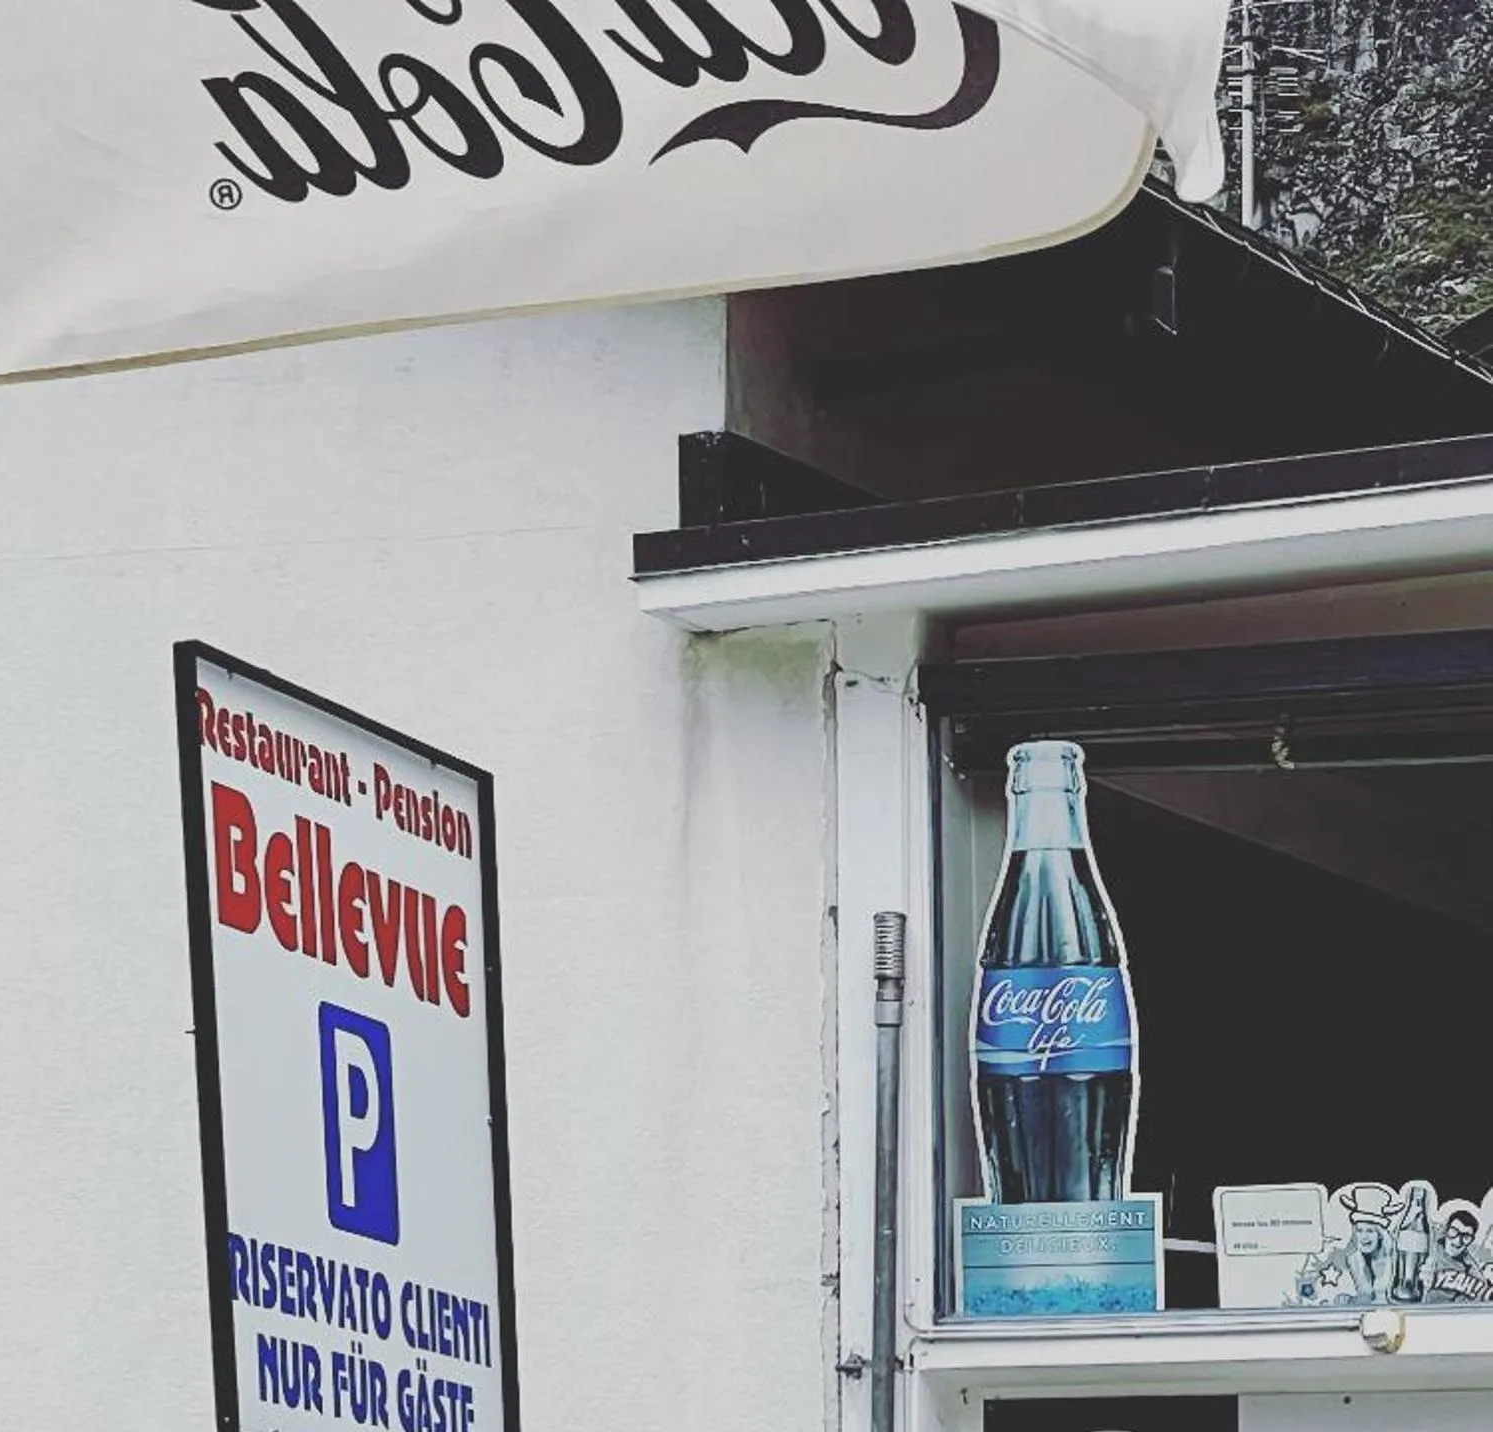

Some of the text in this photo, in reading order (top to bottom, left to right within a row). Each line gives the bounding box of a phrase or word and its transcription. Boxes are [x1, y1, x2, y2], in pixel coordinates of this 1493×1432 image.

[195, 689, 352, 807] Restaurant
[373, 761, 473, 860] Pension
[211, 780, 471, 1018] Bellevue
[981, 975, 1116, 1026] Coca-Cola
[1027, 1022, 1086, 1071] life
[334, 1027, 381, 1208] P
[969, 1211, 1147, 1230] NATURELLEMENT
[227, 1232, 493, 1369] RISERVATO CLIENTI
[256, 1332, 324, 1416] NUR
[331, 1341, 390, 1432] FÜR
